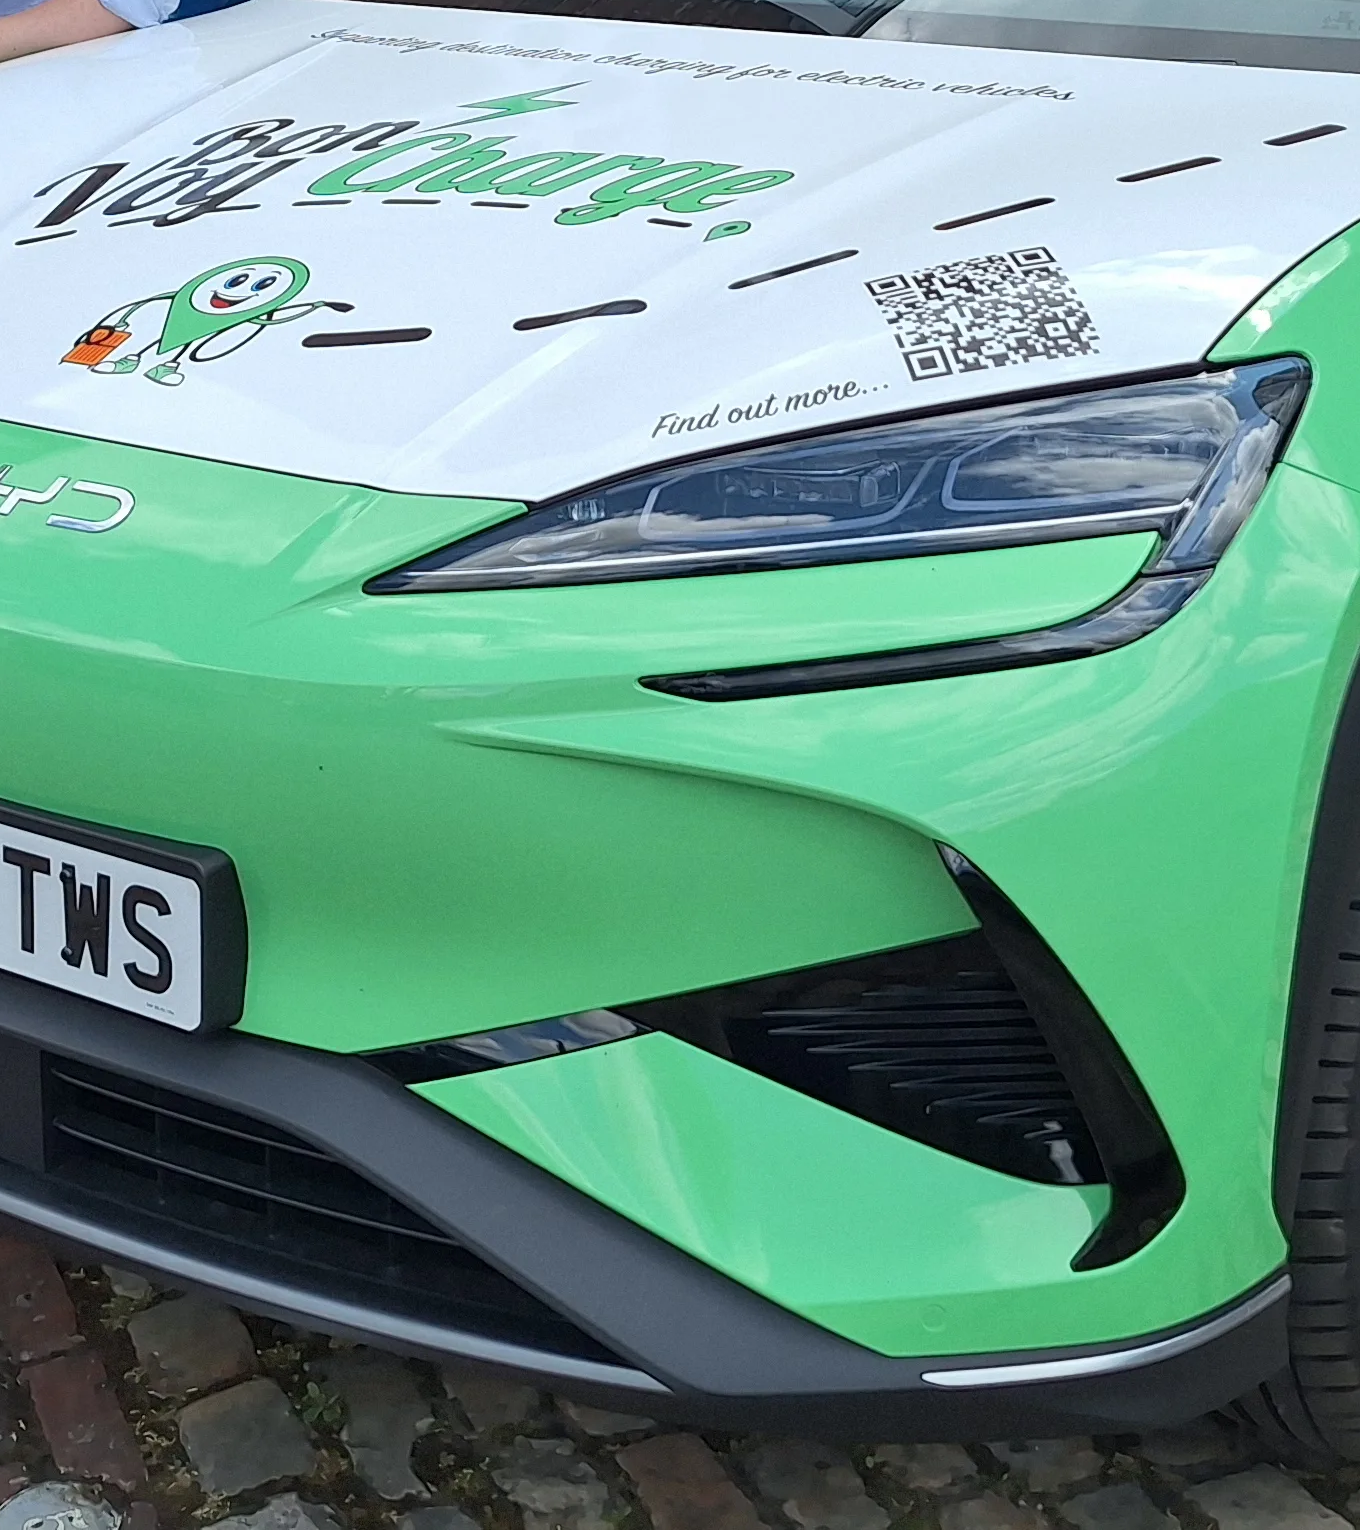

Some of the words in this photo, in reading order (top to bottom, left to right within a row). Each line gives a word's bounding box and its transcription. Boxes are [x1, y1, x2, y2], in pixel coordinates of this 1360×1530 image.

[440, 41, 592, 63] destination
[593, 52, 737, 80] charging
[726, 63, 792, 81] for
[797, 69, 925, 90] electric
[932, 81, 1076, 102] vehicles
[166, 118, 420, 171] Bon
[307, 131, 795, 227] Charge
[651, 403, 721, 439] Find
[727, 393, 779, 424] out
[784, 380, 889, 413] more...
[2, 844, 173, 995] TWS
